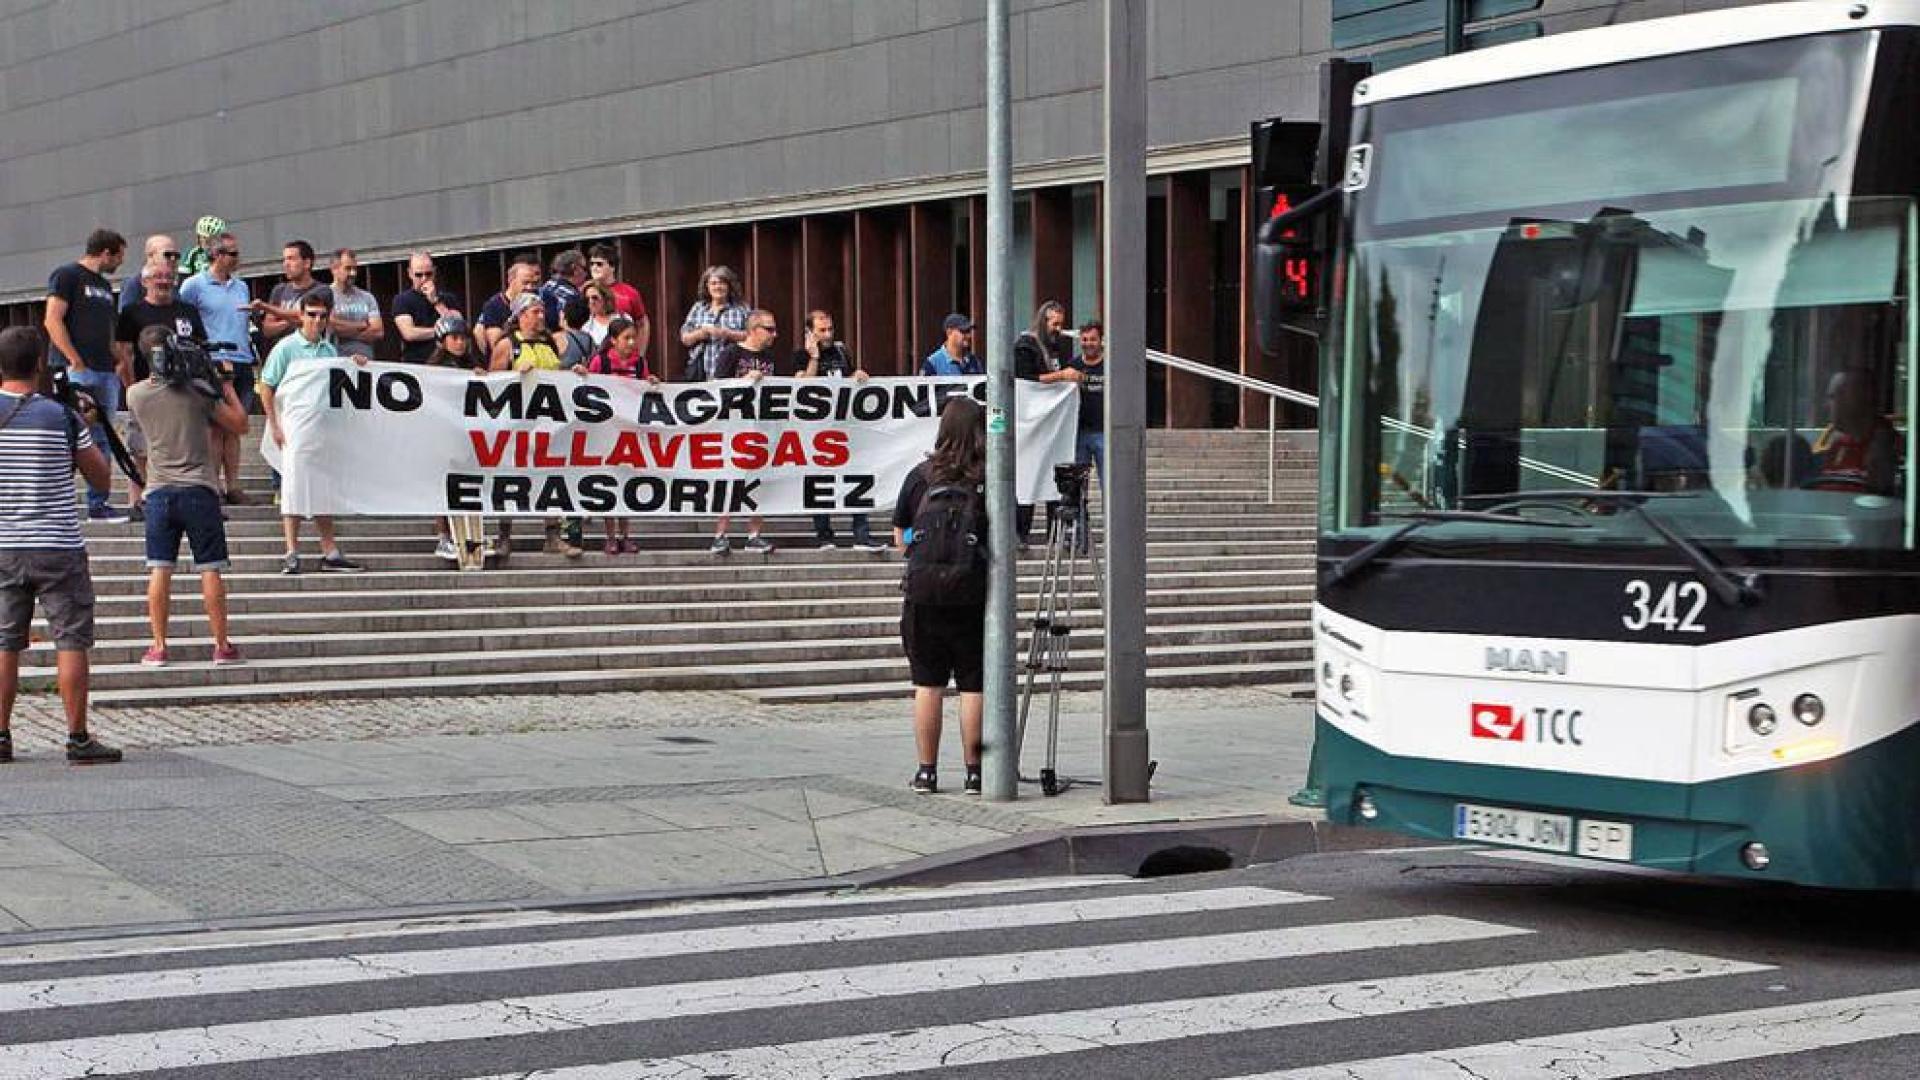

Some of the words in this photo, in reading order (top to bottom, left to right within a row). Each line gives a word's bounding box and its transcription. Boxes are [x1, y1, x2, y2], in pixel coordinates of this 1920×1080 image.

[1285, 258, 1308, 297] 4
[330, 368, 423, 411] NO
[465, 381, 613, 423] MAS
[469, 431, 848, 468] VILLAVESAS
[447, 475, 759, 512] ERASORIK
[804, 476, 874, 508] EZ
[1623, 581, 1706, 631] 342
[1485, 646, 1568, 675] MAN
[1533, 706, 1583, 746] TCC
